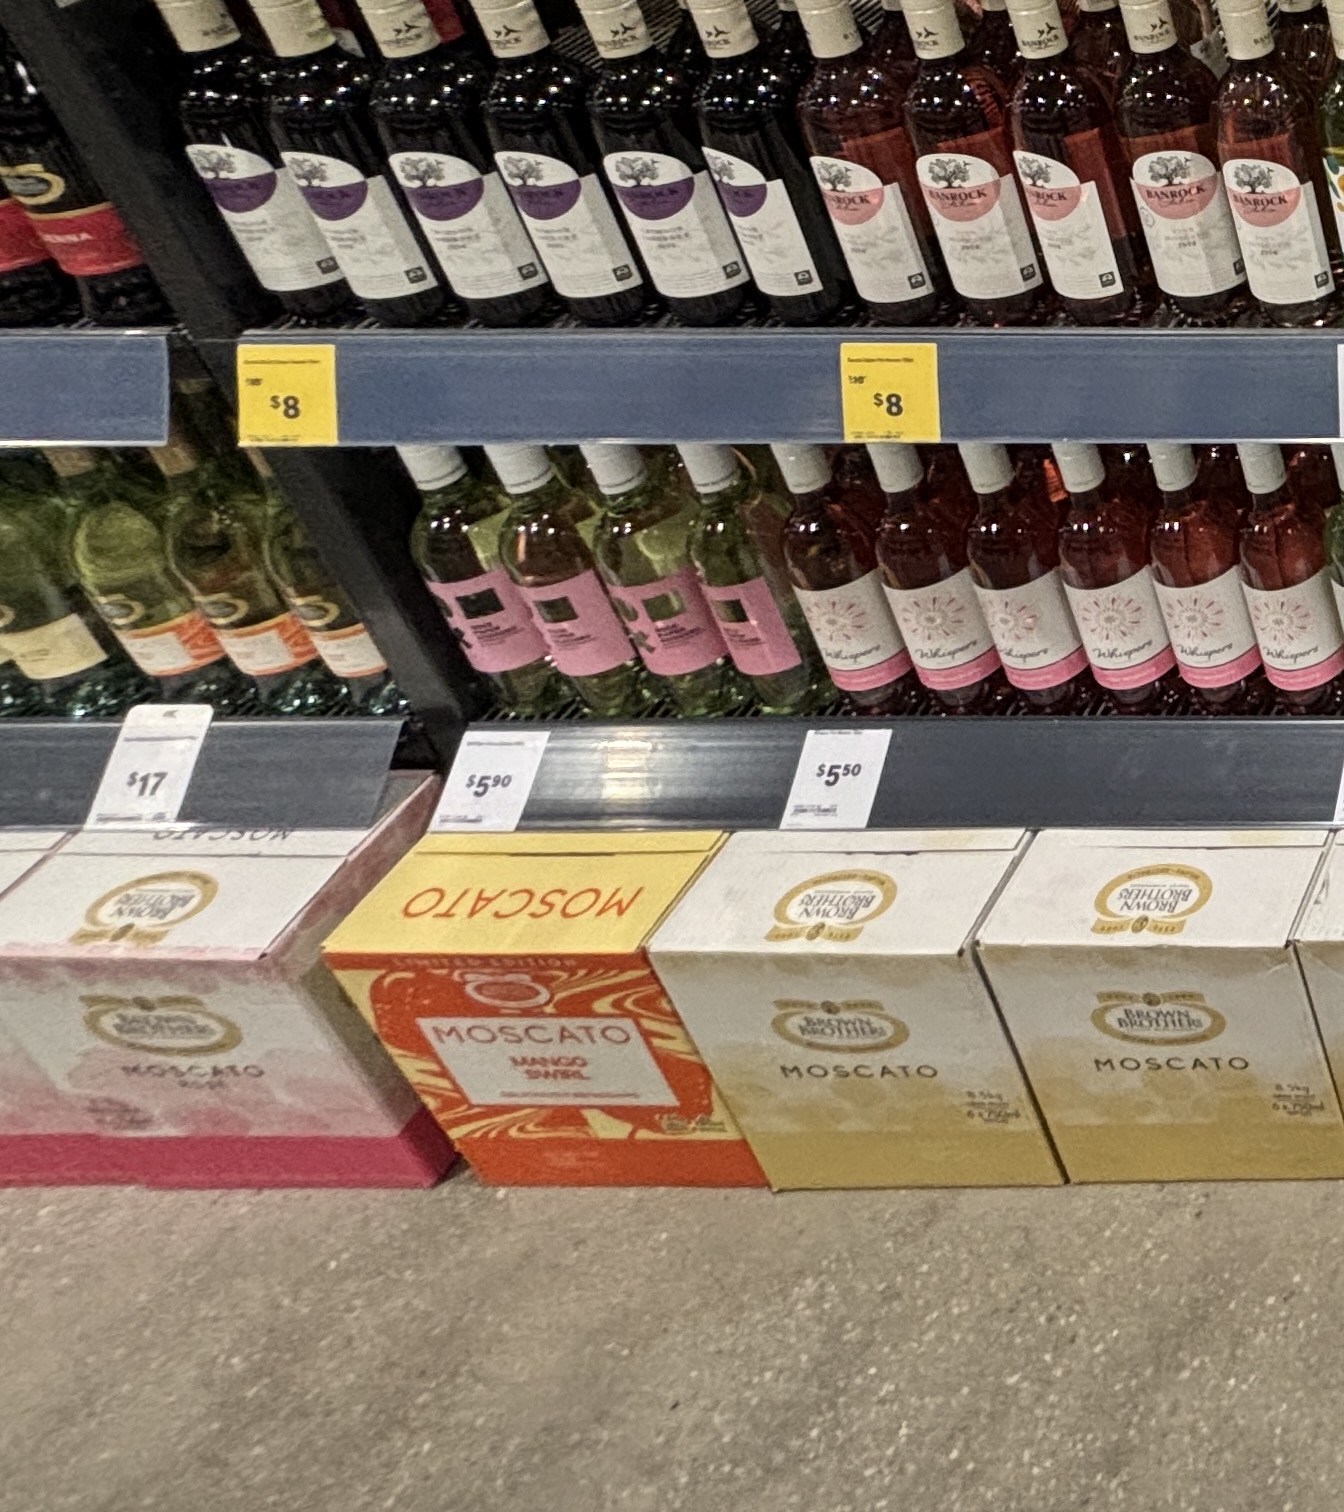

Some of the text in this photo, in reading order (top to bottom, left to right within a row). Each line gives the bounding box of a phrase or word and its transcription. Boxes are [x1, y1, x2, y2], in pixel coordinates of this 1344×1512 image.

[269, 394, 301, 420] $8
[873, 392, 904, 417] $8
[127, 770, 168, 798] $17
[401, 886, 646, 919] MOSCATO
[432, 1024, 632, 1046] MOSCATO
[779, 1063, 938, 1079] MOSCATO
[1093, 1056, 1250, 1072] MOSCATO
